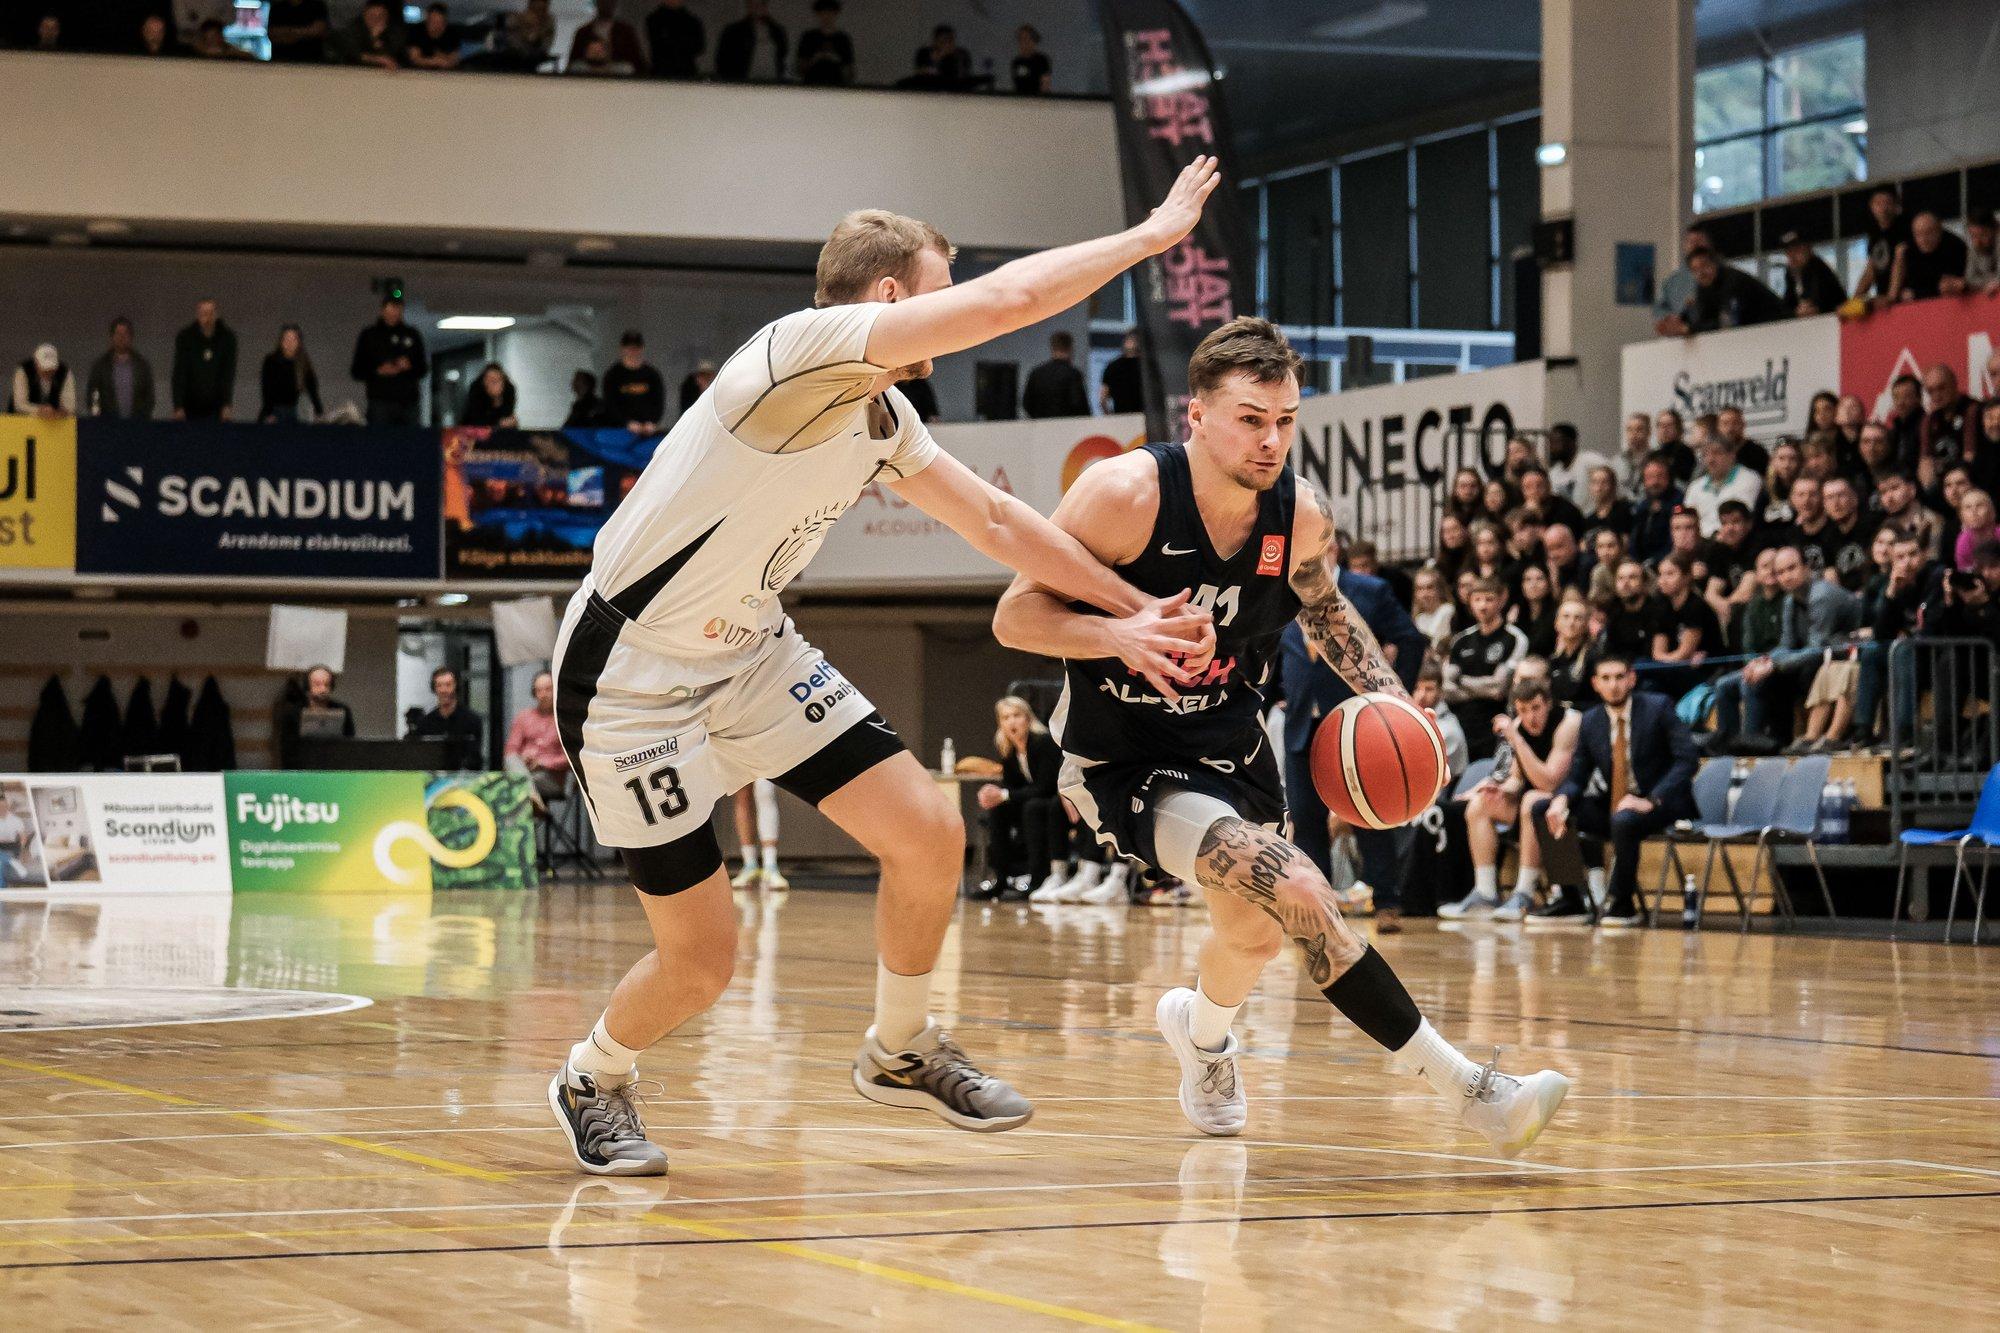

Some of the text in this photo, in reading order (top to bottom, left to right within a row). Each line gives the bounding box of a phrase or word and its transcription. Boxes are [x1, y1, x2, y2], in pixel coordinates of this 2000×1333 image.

[1299, 402, 1515, 500] NNECTO
[157, 475, 415, 521] SCANDIUM
[823, 682, 856, 709] Daily
[613, 736, 678, 768] Scanweld
[237, 792, 340, 832] Fujitsu
[624, 765, 690, 826] 13
[105, 818, 216, 843] Scandium
